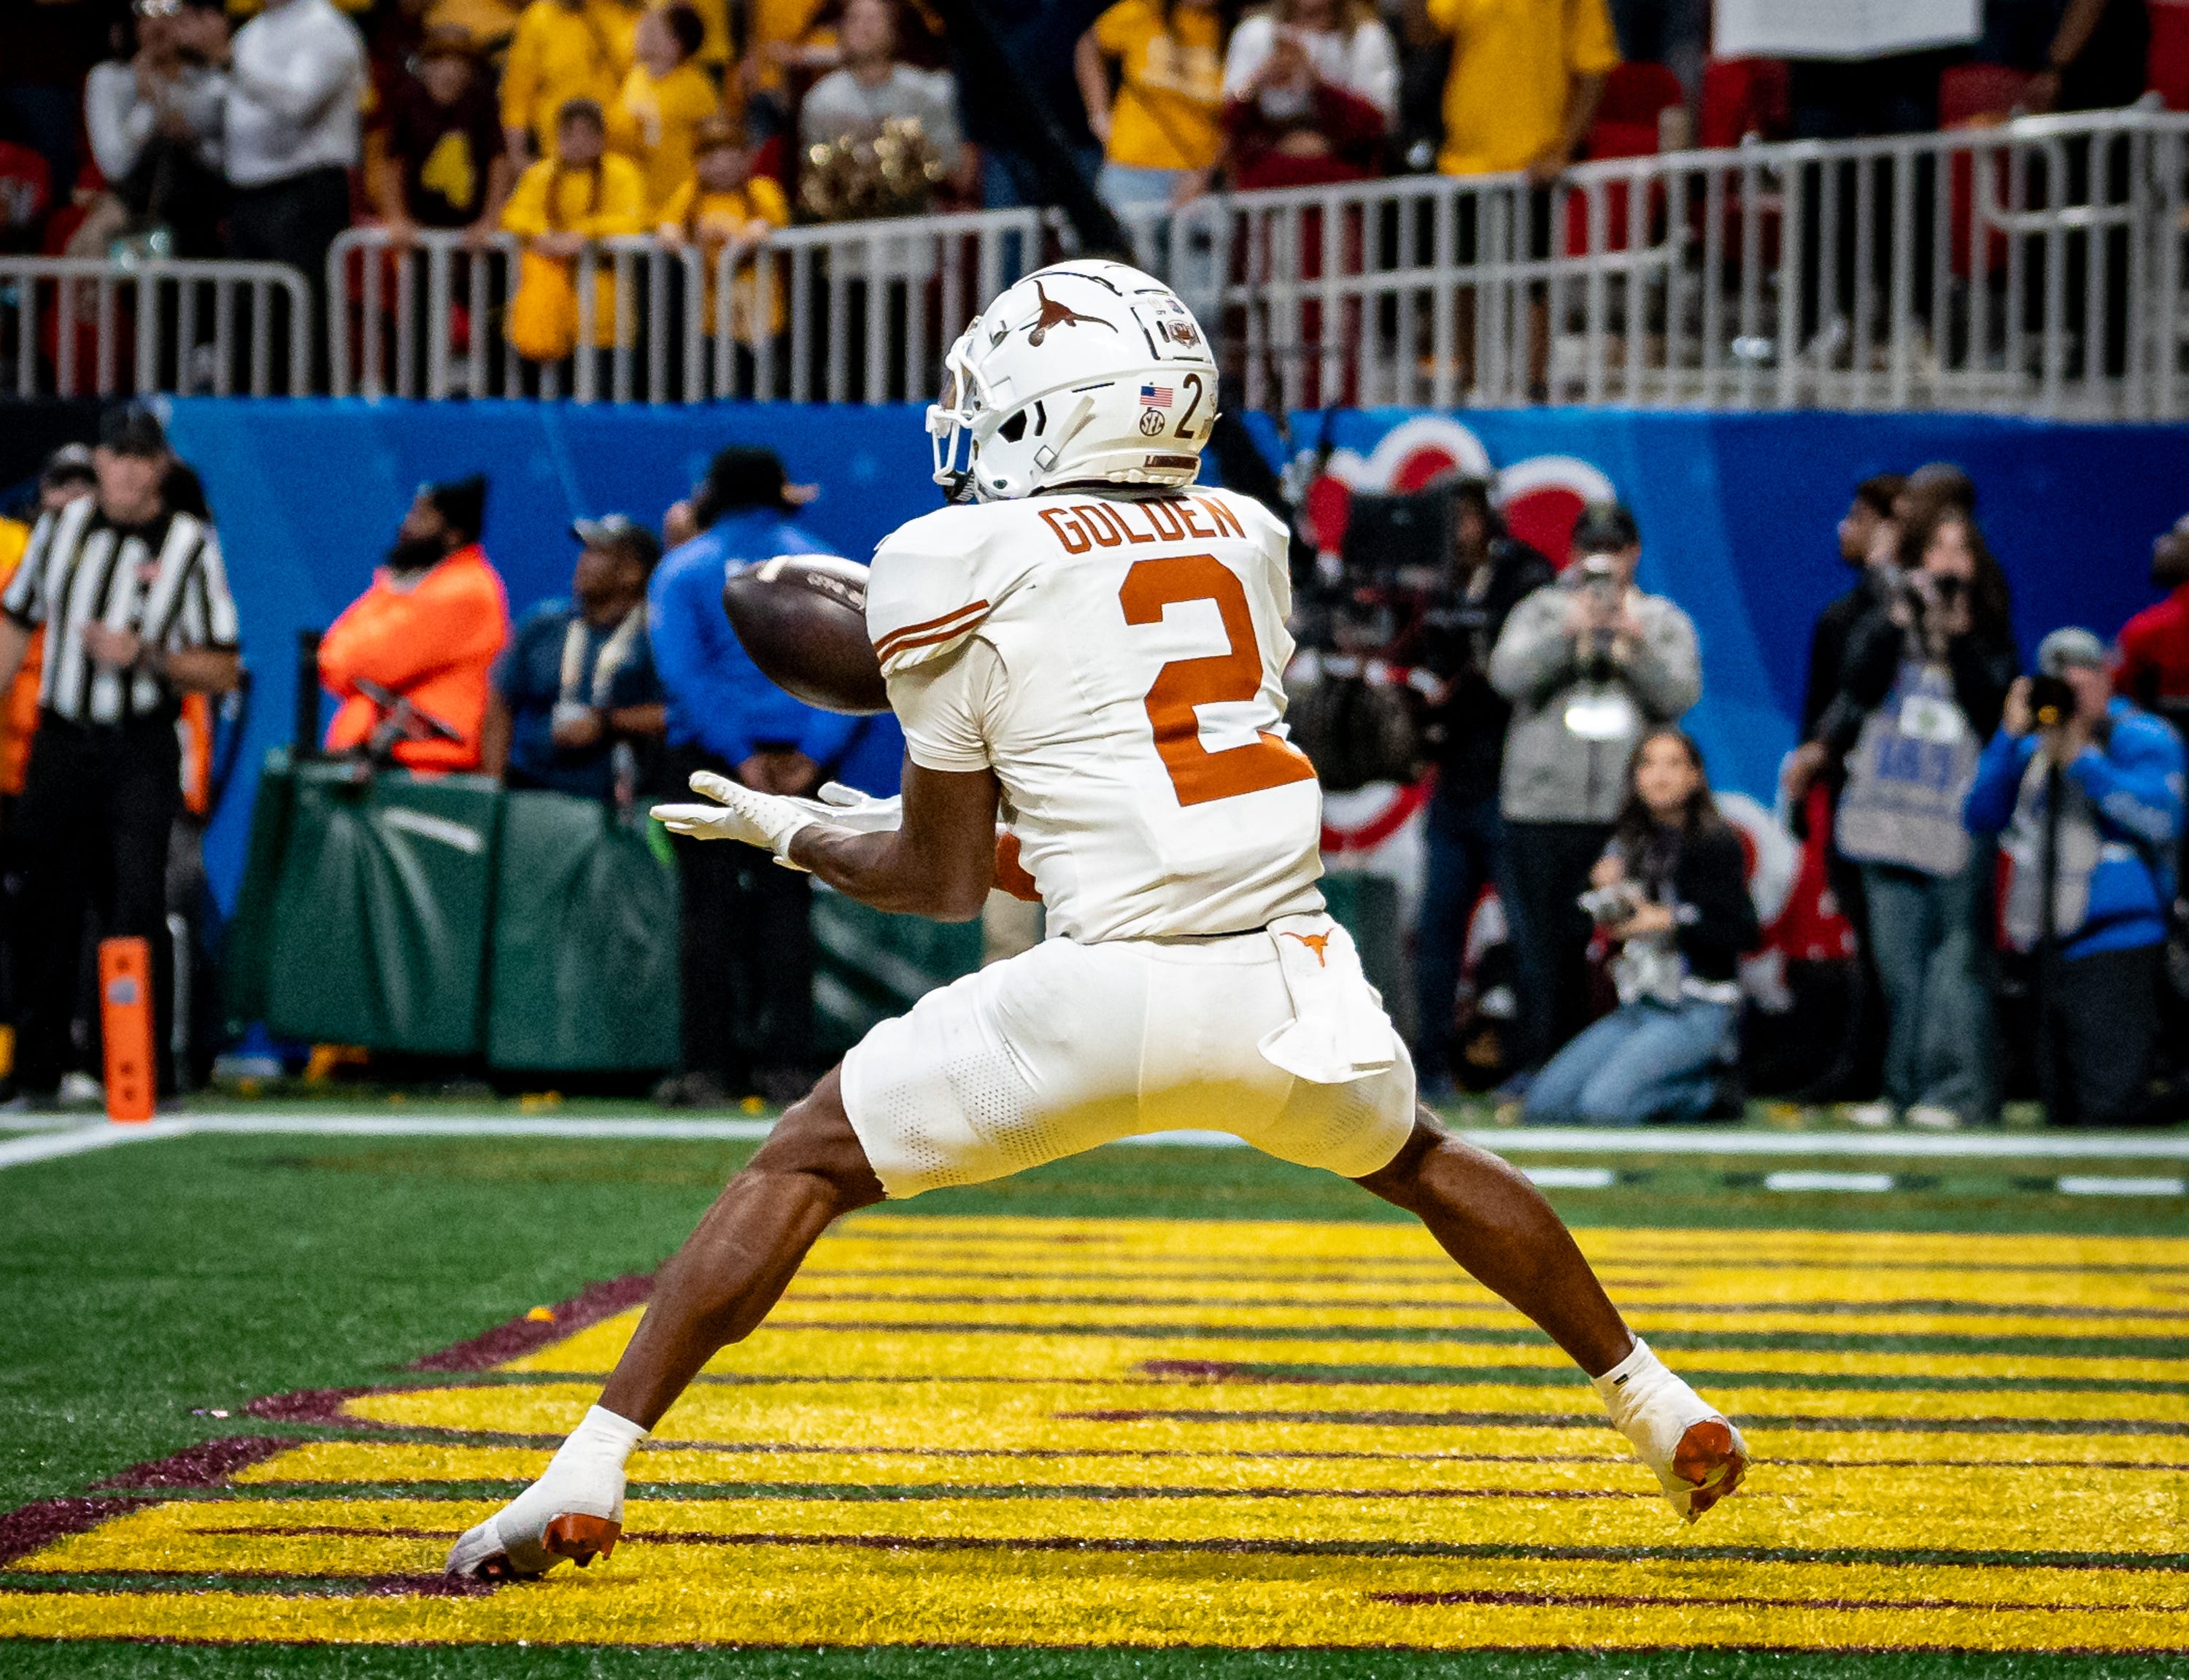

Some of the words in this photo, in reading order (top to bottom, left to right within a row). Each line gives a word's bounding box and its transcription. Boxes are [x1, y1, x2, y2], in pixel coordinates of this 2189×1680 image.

[1140, 410, 1165, 436] SEC
[1174, 373, 1202, 439] 2
[1038, 495, 1247, 554] GOLDEN
[1119, 554, 1319, 808] 2
